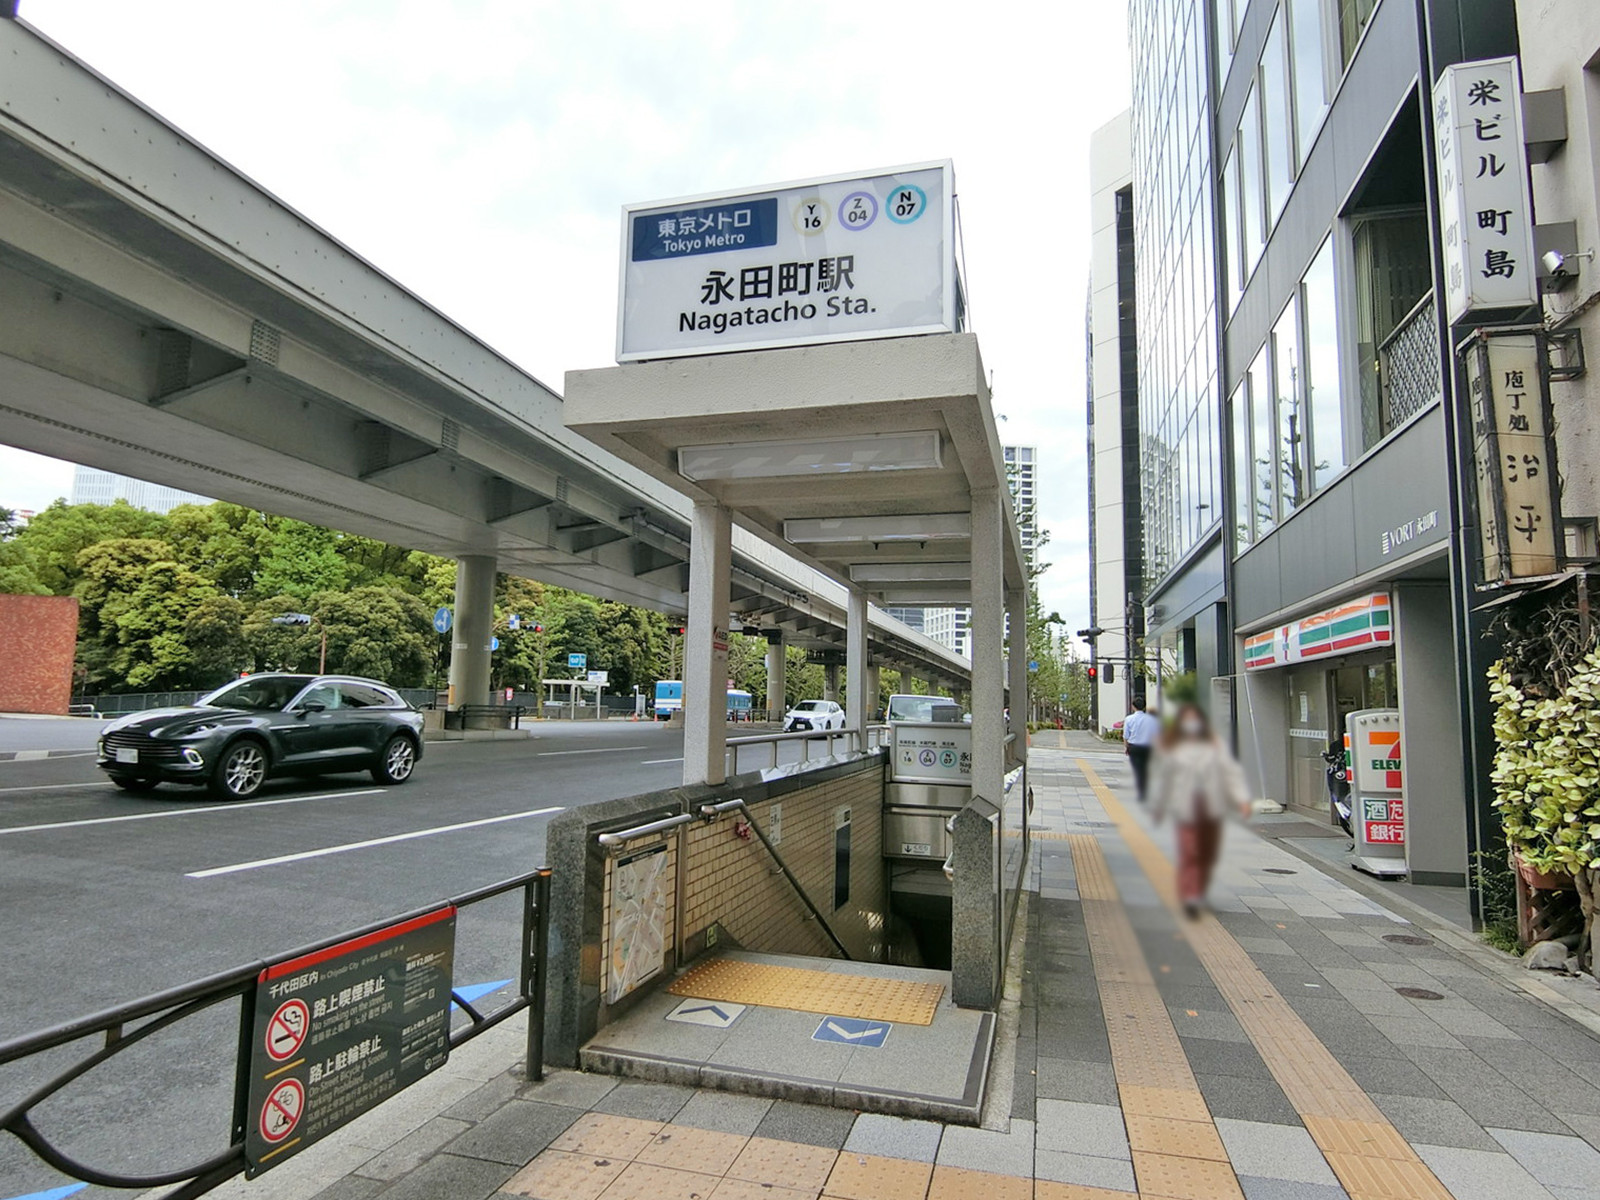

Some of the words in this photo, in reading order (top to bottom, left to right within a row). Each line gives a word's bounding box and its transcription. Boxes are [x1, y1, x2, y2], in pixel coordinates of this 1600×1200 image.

[854, 197, 863, 209] Z
[900, 190, 912, 203] N
[806, 204, 816, 215] Y
[848, 208, 868, 223] 04
[896, 202, 916, 217] 07
[657, 208, 751, 238] 東京メトロ
[803, 216, 821, 229] 16
[663, 234, 703, 253] Tokyo
[705, 231, 746, 248] Metro
[701, 255, 855, 305] 永田町駅
[679, 301, 817, 334] Nagatacho
[826, 295, 877, 318] Sta.
[1390, 520, 1415, 547] VORT
[1366, 800, 1387, 820] 酒
[269, 971, 319, 999] 千代田区内
[312, 1021, 322, 1032] No
